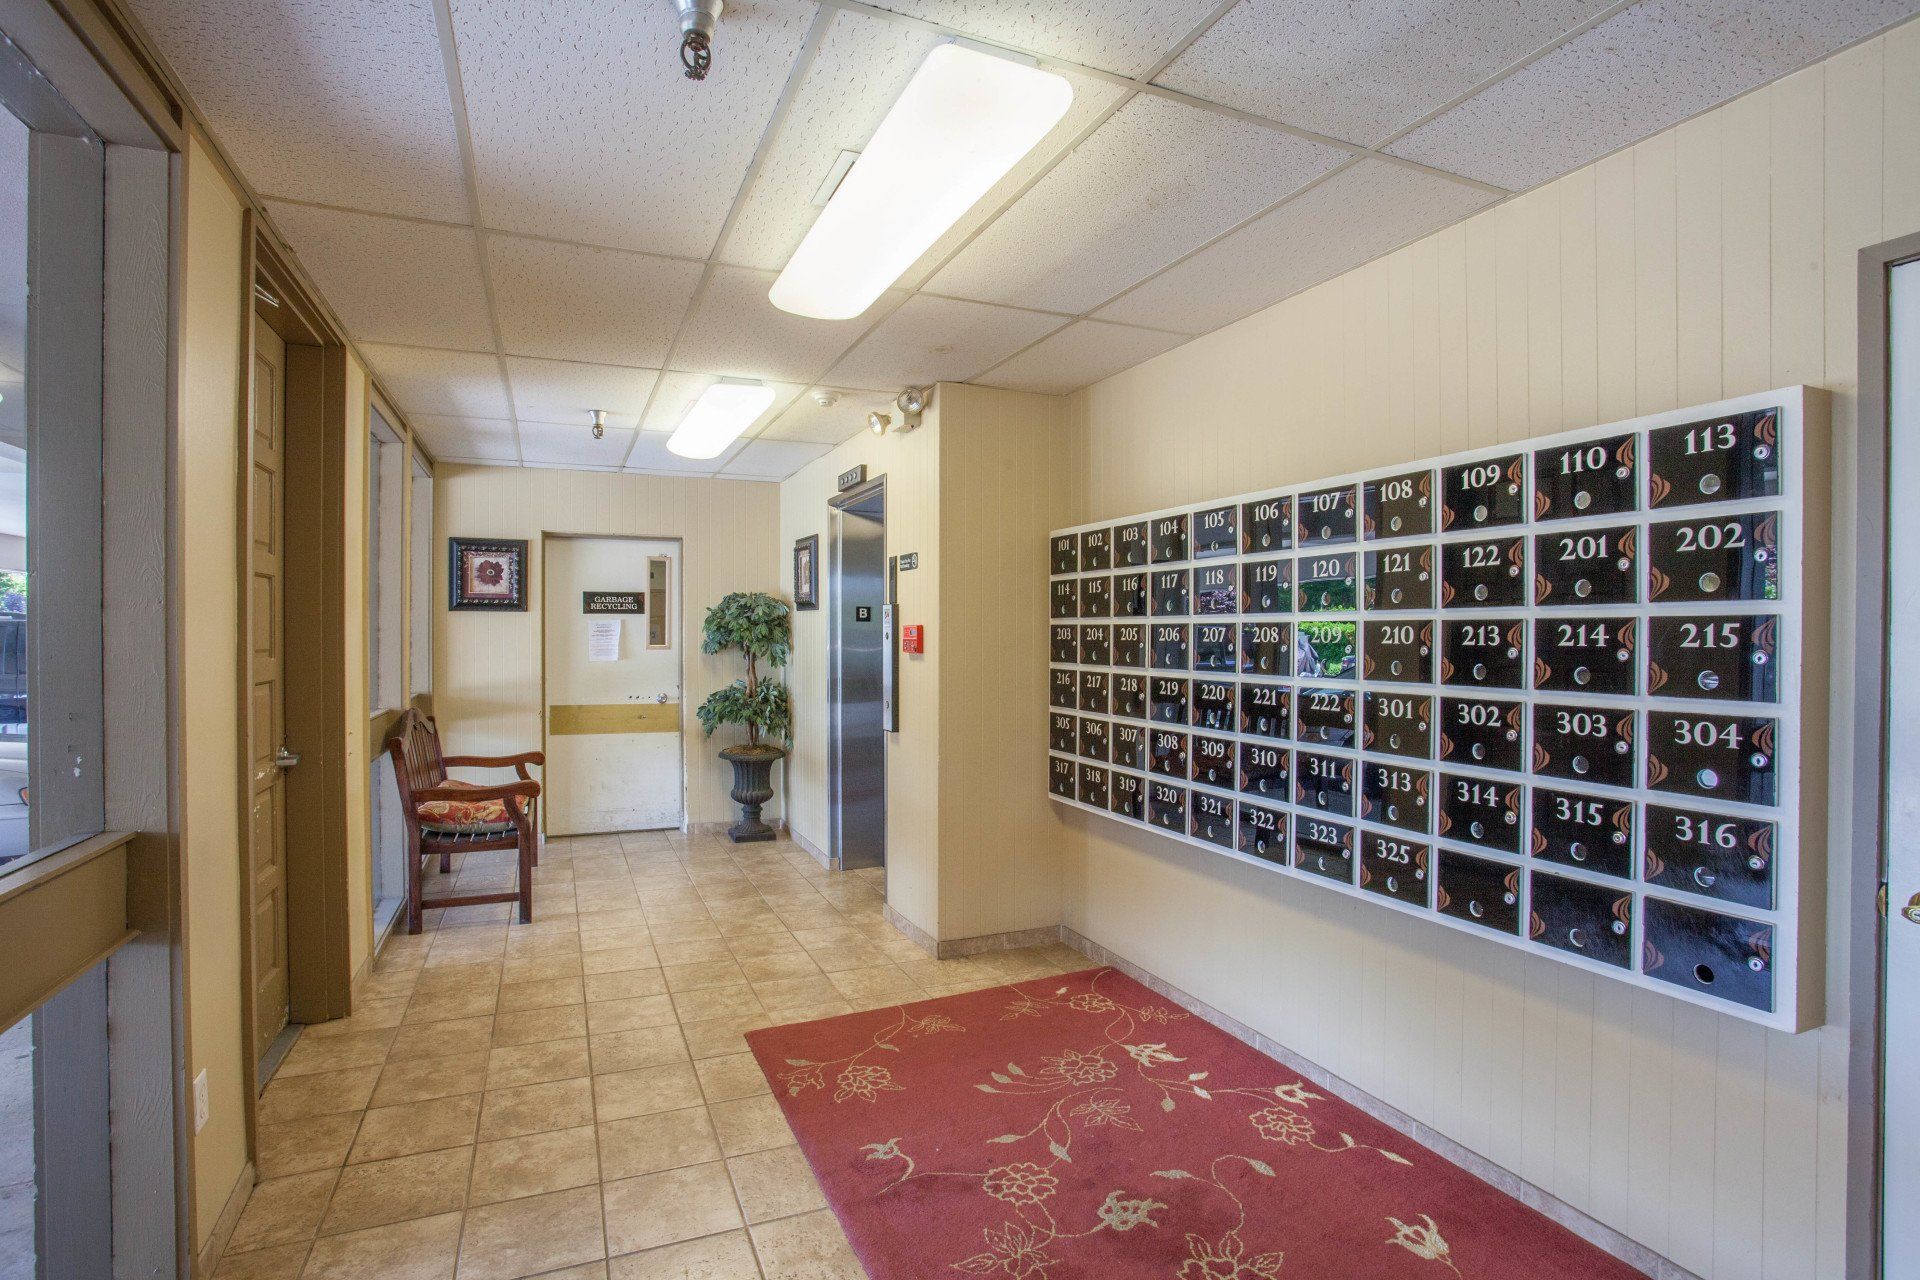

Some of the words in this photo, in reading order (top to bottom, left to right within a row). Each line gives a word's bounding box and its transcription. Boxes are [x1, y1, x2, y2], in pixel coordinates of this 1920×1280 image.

[1684, 423, 1737, 455] 113
[1560, 446, 1607, 475] 110
[1461, 464, 1501, 490] 109
[1380, 479, 1413, 502] 108
[1312, 492, 1340, 513] 107
[1204, 512, 1225, 529] 105
[1254, 503, 1279, 522] 106
[1122, 527, 1139, 541] 103
[1159, 520, 1178, 536] 104
[1057, 538, 1070, 552] 101
[1088, 533, 1103, 547] 102
[1676, 523, 1746, 553] 202
[1462, 545, 1501, 568] 122
[1559, 534, 1608, 561] 201
[1312, 559, 1340, 578] 120
[1383, 553, 1411, 574] 121
[1161, 574, 1178, 589] 117
[1205, 569, 1224, 585] 118
[1255, 565, 1278, 583] 119
[1057, 584, 1070, 595] 114
[1088, 580, 1102, 594] 115
[1122, 577, 1138, 591] 116
[859, 608, 868, 618] B
[1056, 627, 1071, 640] 203
[1086, 627, 1103, 641] 204
[1120, 627, 1138, 641] 205
[1158, 627, 1180, 642] 206
[1202, 627, 1226, 642] 207
[1252, 627, 1279, 643] 208
[1311, 627, 1342, 644] 209
[1381, 625, 1414, 644] 210
[1461, 625, 1500, 647] 213
[1557, 624, 1610, 648] 214
[1679, 623, 1741, 649] 215
[1056, 672, 1071, 685] 216
[1086, 674, 1102, 688] 217
[1120, 677, 1138, 692] 218
[1159, 681, 1179, 696] 219
[1201, 685, 1226, 701] 220
[1253, 688, 1276, 706] 221
[1310, 693, 1341, 712] 222
[1378, 698, 1413, 719] 301
[1055, 716, 1070, 730] 305
[1457, 703, 1502, 727] 302
[1085, 723, 1102, 736] 306
[1557, 711, 1607, 738] 303
[1119, 727, 1137, 743] 307
[1157, 733, 1178, 750] 308
[1674, 719, 1743, 750] 304
[1201, 740, 1225, 758] 309
[1251, 748, 1277, 767] 310
[1055, 761, 1069, 774] 317
[1085, 768, 1101, 783] 318
[1310, 758, 1336, 779] 311
[1119, 776, 1136, 792] 319
[1378, 769, 1412, 792] 313
[1156, 786, 1177, 804] 320
[1457, 781, 1499, 808] 314
[1201, 796, 1222, 816] 321
[1556, 797, 1604, 827] 315
[1249, 809, 1275, 831] 322
[1309, 822, 1338, 845] 323
[1675, 816, 1737, 849] 316
[1377, 839, 1410, 864] 325
